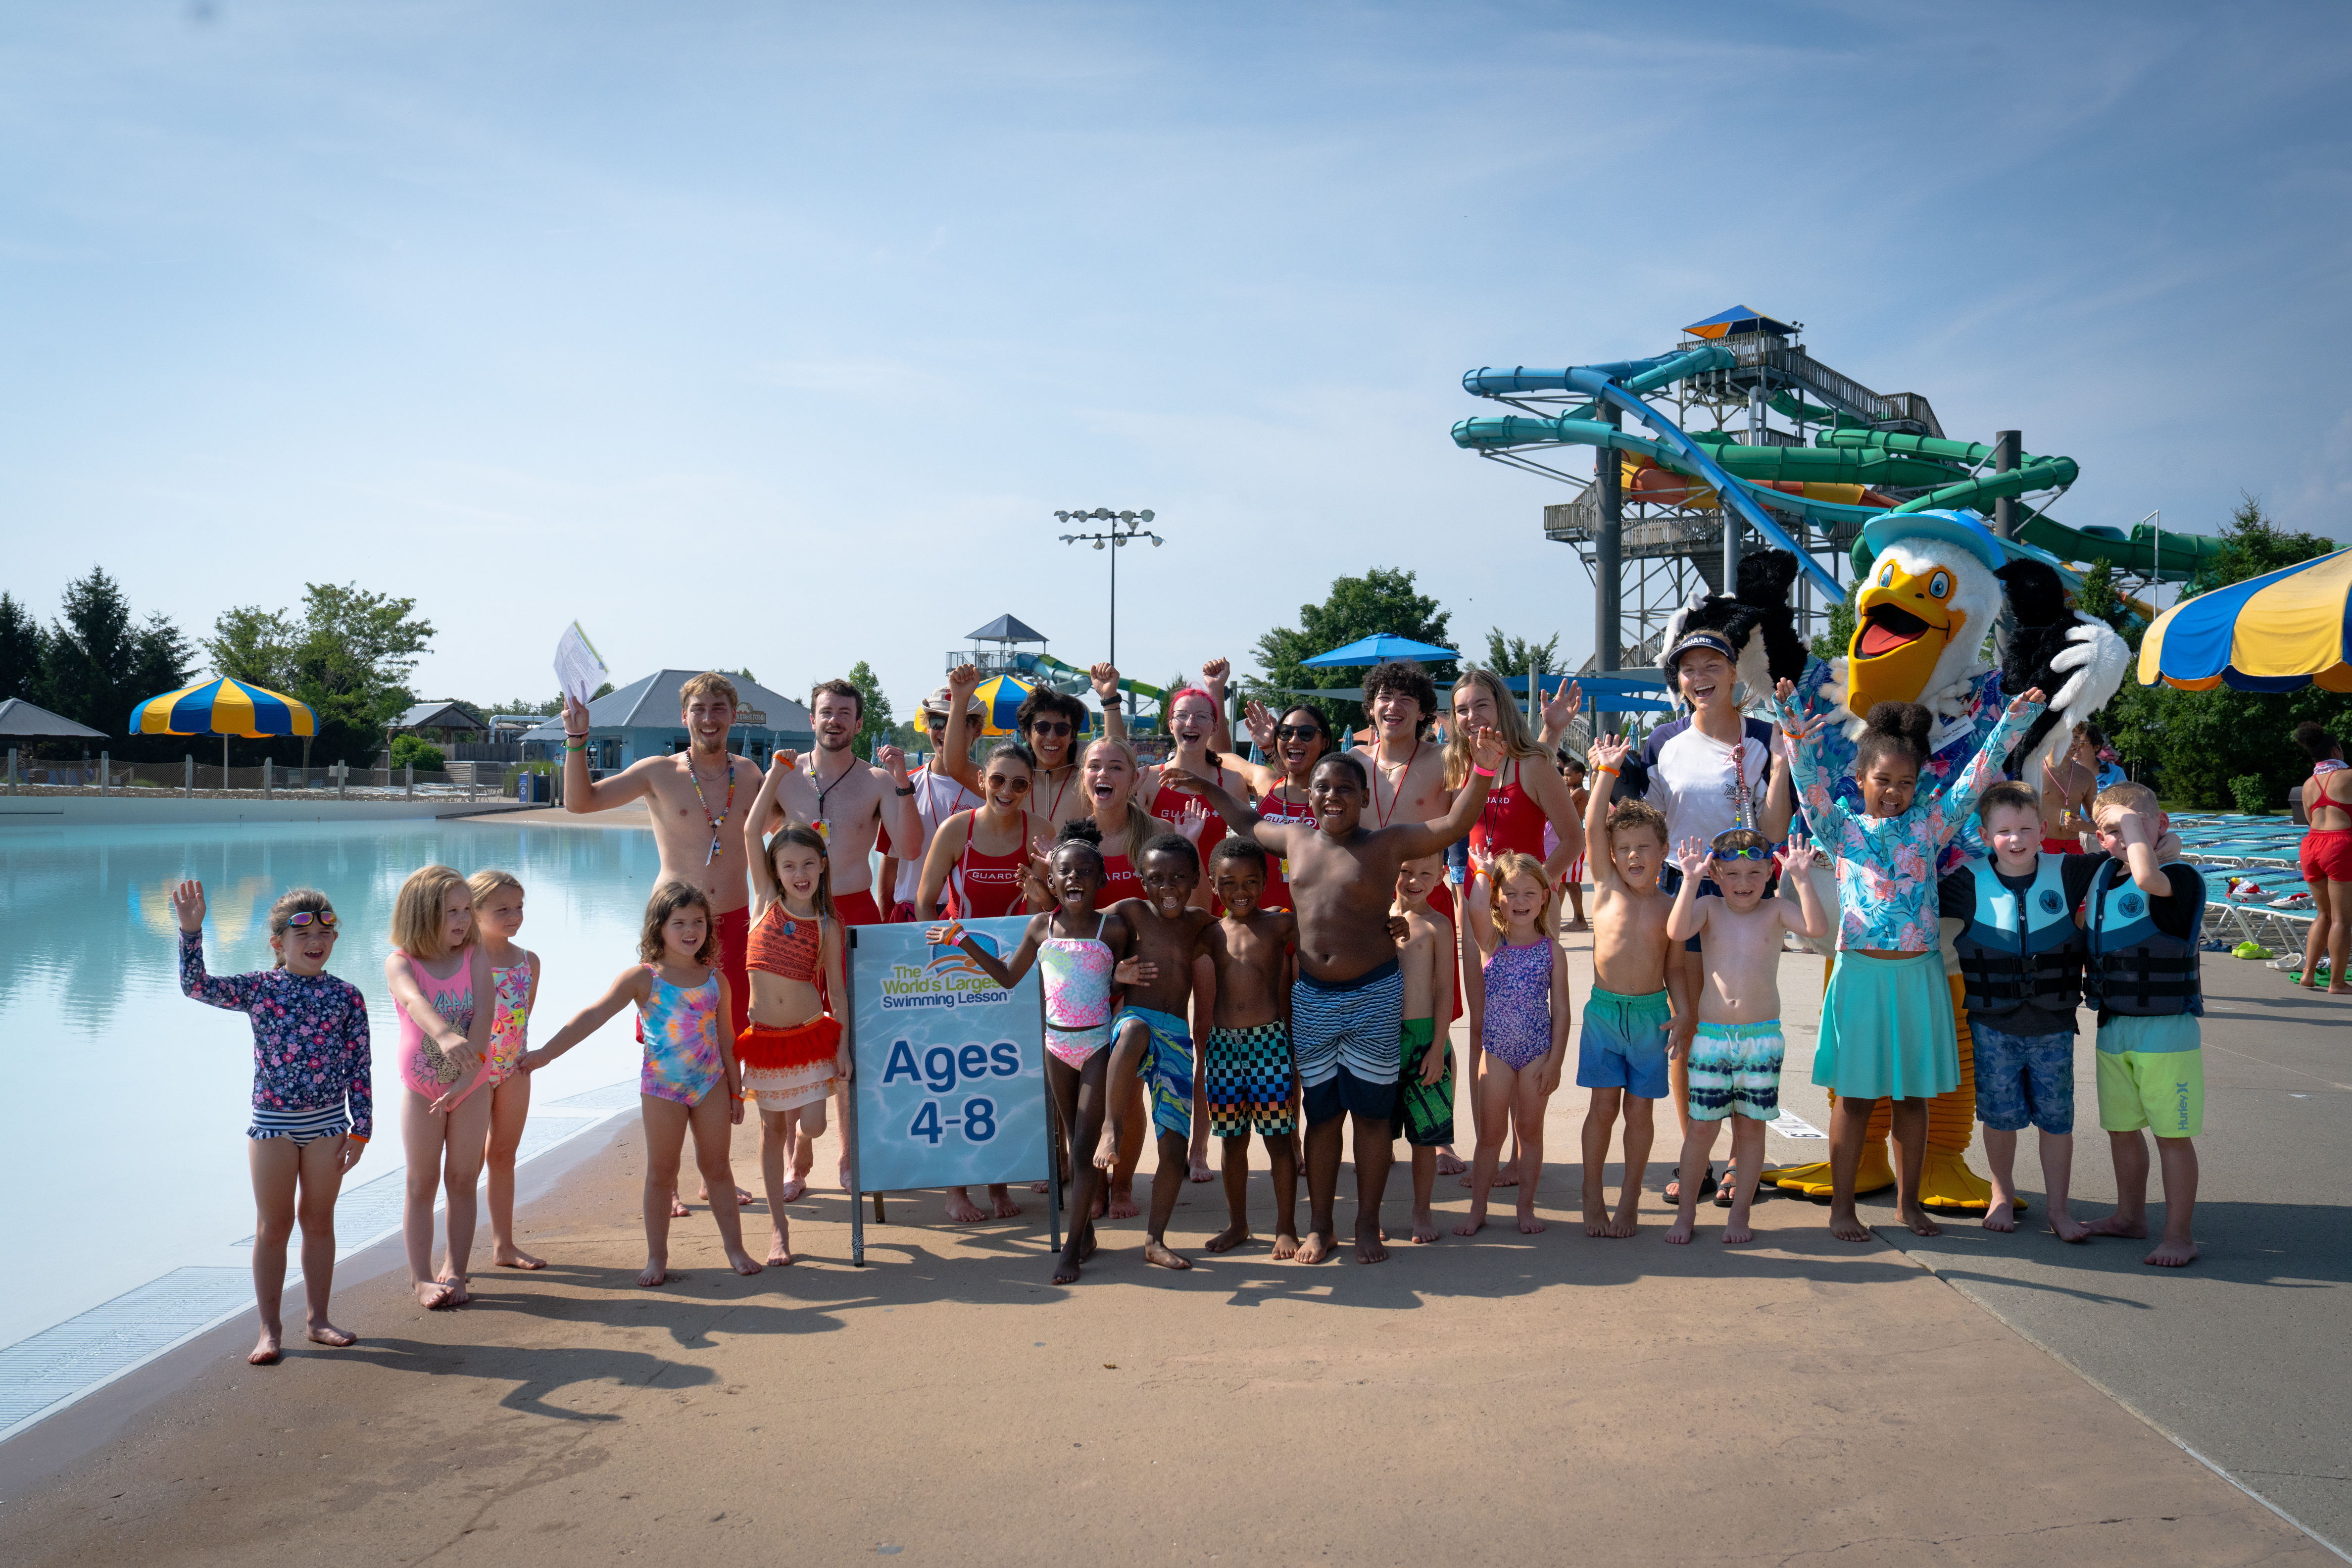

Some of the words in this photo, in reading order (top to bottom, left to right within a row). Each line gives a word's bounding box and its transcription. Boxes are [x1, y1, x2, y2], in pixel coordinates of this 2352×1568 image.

[1952, 723, 1967, 733] Pelican
[893, 966, 922, 980] The
[946, 977, 1002, 994] Larges
[883, 993, 955, 1008] Swimming
[882, 1040, 1020, 1093] Ages
[2177, 1094, 2189, 1130] Hurley
[911, 1098, 996, 1144] 4-8
